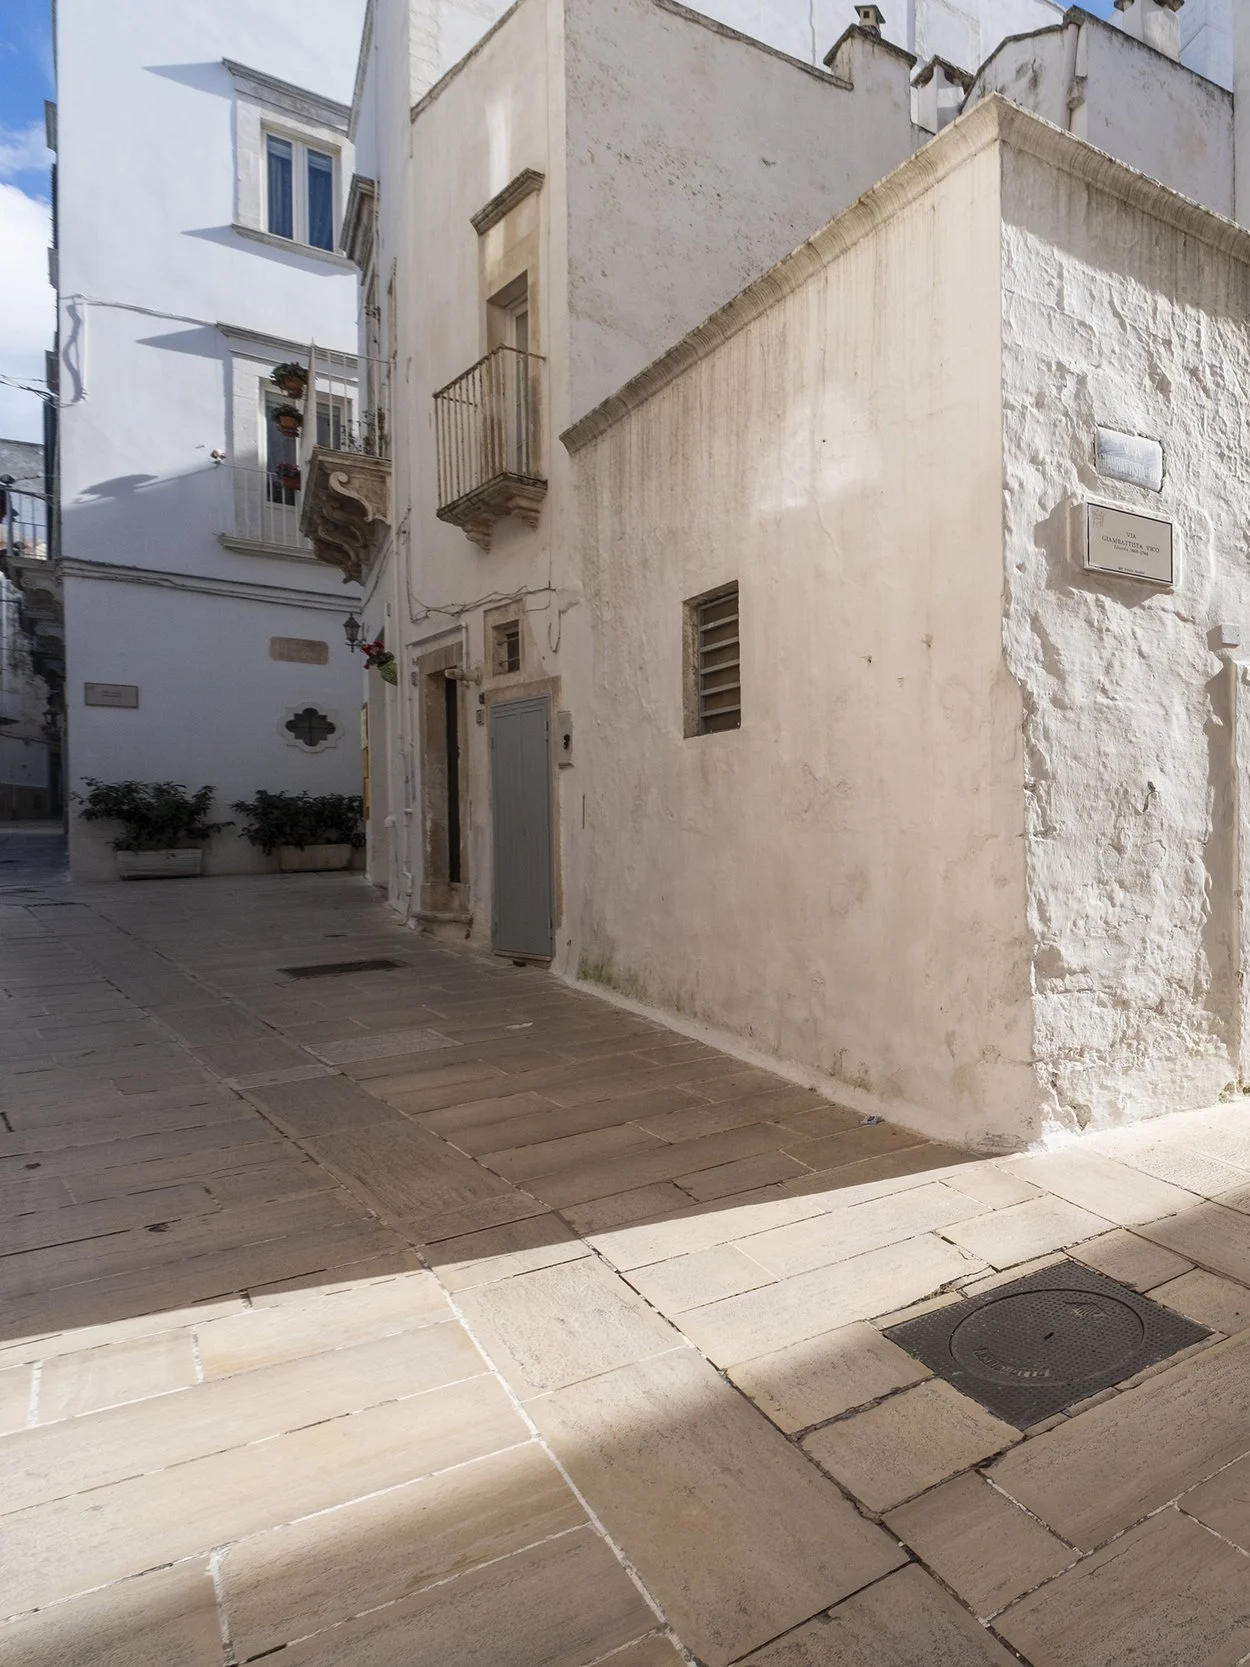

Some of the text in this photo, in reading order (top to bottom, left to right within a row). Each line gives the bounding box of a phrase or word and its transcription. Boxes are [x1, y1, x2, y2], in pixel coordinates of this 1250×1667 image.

[1126, 531, 1137, 540] VIA
[1101, 535, 1160, 554] GIAMBATTISTA VICO
